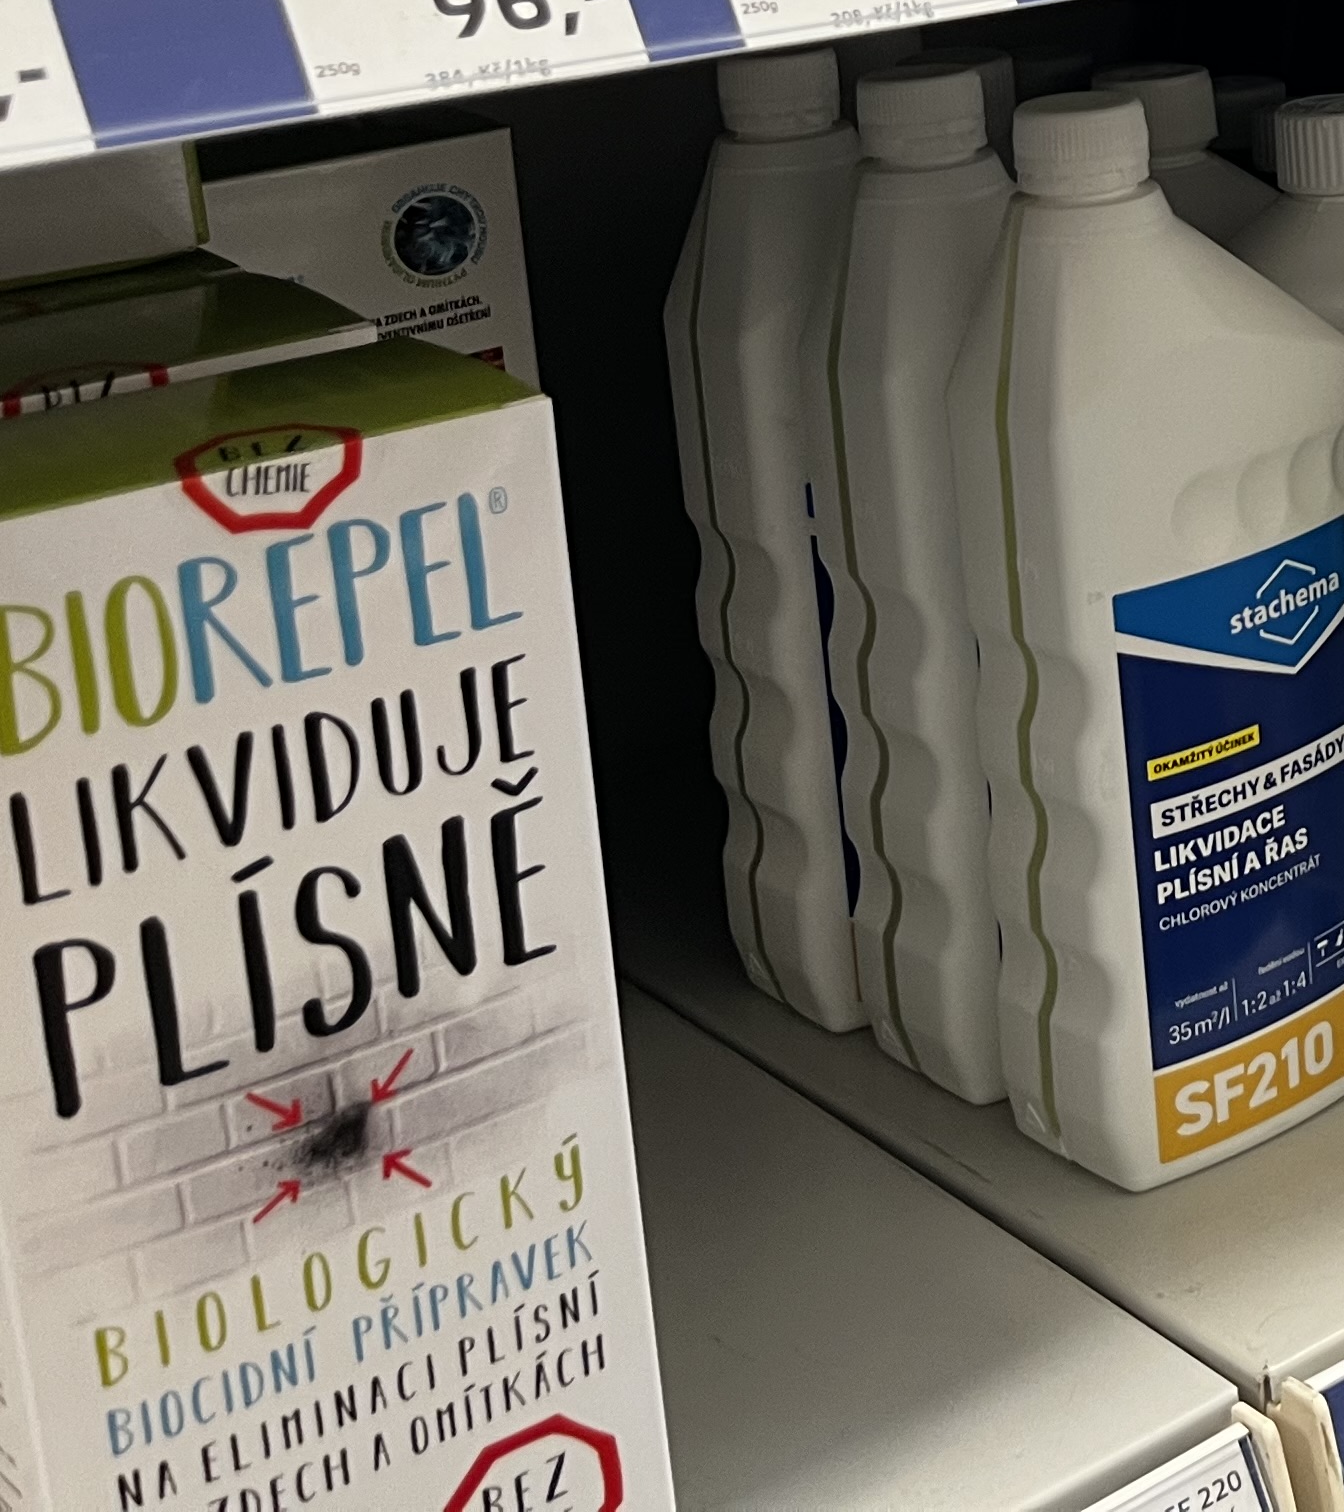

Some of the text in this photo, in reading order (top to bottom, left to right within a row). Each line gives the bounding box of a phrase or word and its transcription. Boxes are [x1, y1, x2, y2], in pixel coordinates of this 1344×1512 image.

[225, 461, 312, 499] CHEMIE
[1229, 570, 1341, 636] stachema
[10, 655, 534, 906] LIKVIDUJE
[1153, 727, 1256, 776] OKAMŽITÝ ÚČINEK
[1161, 775, 1260, 827] STŘECHY
[1262, 771, 1278, 791] &
[1154, 805, 1286, 873] LIKVIDACE
[1157, 826, 1309, 905] PLÍSNÍ A ŘAS
[32, 767, 558, 1118] PLÍSNĚ
[1159, 854, 1322, 932] CHLOROVÝ KONCENTRÁT
[1175, 1018, 1335, 1137] SF210
[94, 1132, 585, 1388] BIOLOGICKÝ
[106, 1220, 594, 1457] BIOCIDNÍ PŘÍPRAVEK
[116, 1269, 601, 1511] NA ELIMINACI PLÍSNÍ
[372, 1434, 393, 1471] A
[410, 1332, 607, 1455] OMÍTKÁCH
